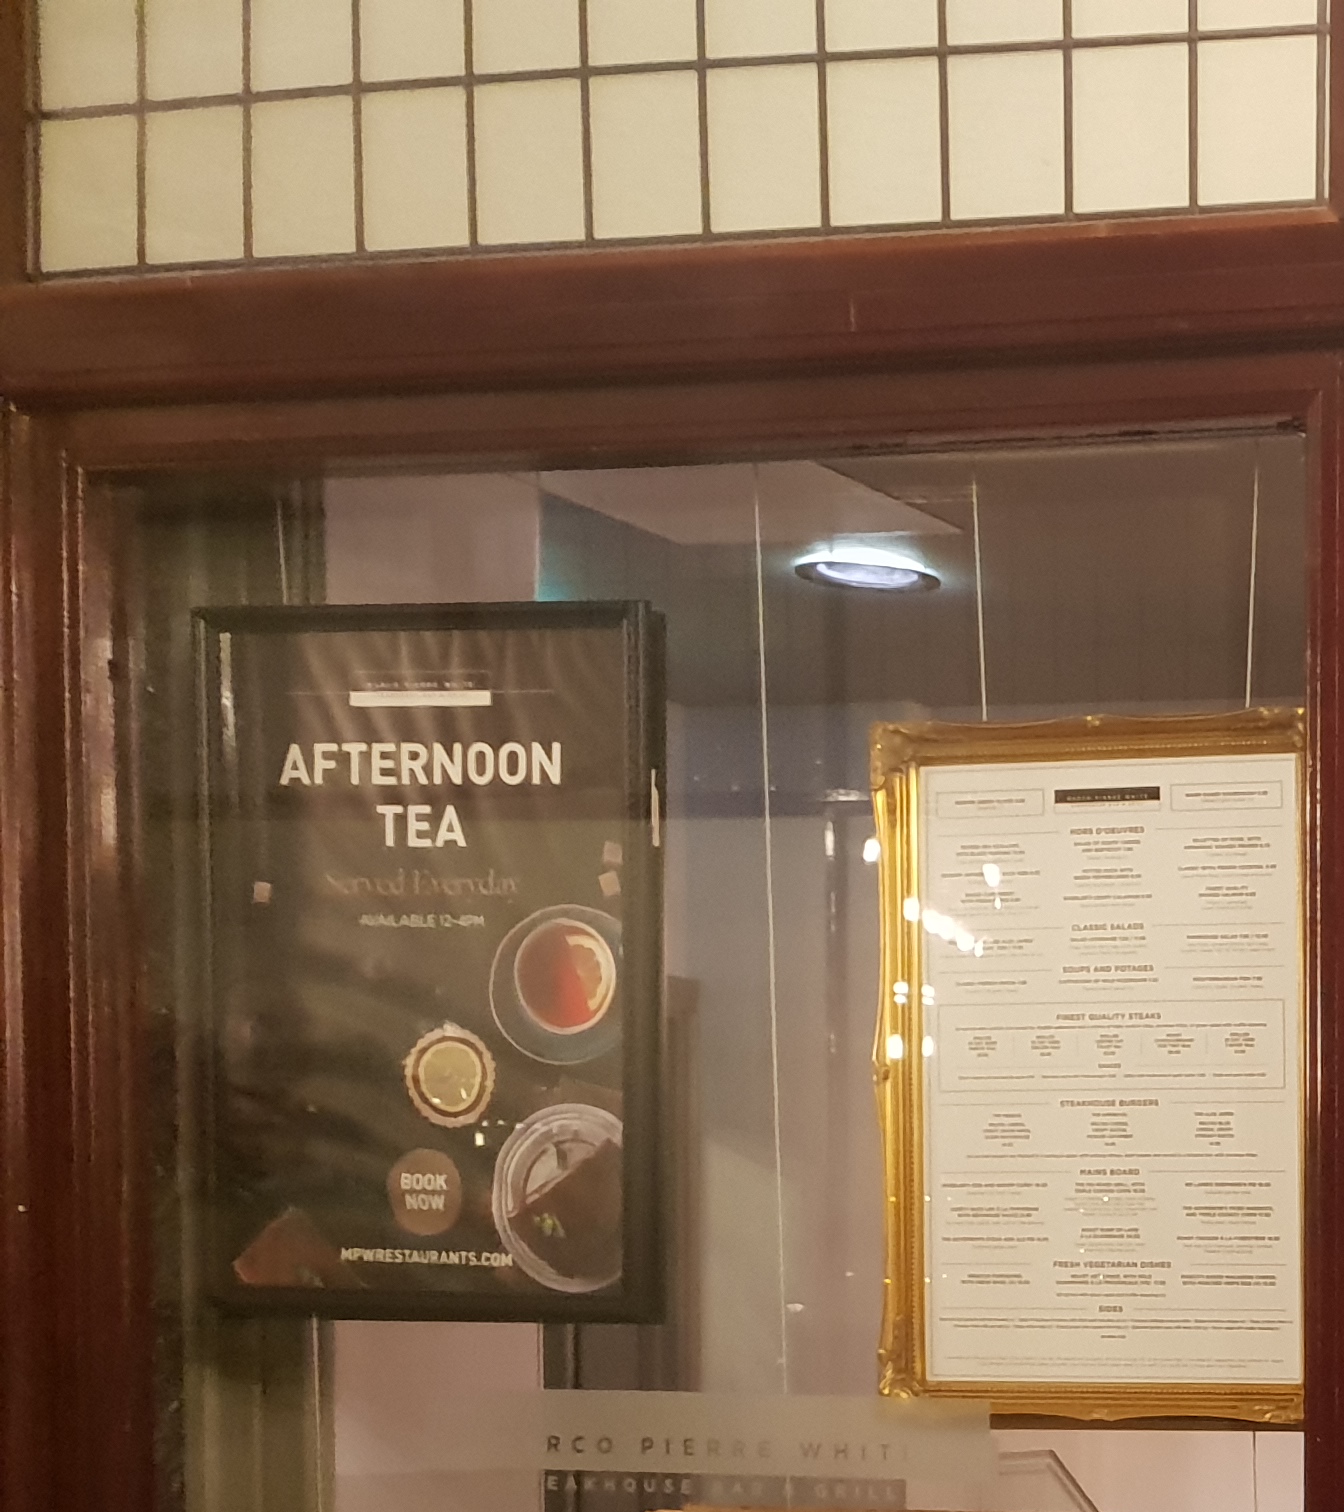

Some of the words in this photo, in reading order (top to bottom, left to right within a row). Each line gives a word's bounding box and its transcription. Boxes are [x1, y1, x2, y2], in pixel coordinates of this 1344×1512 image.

[279, 741, 563, 788] AFTERNOON
[376, 803, 467, 849] TEA
[359, 913, 437, 928] AVAILABLE
[1088, 1012, 1126, 1021] QUALITY
[1128, 1012, 1162, 1021] STEAKS
[399, 1171, 448, 1192] BOOK
[1079, 1168, 1108, 1176] MAINS
[1109, 1168, 1140, 1176] BOARD
[405, 1193, 446, 1212] NOW
[340, 1246, 514, 1269] MPWRESTAURANTS.COM
[546, 1434, 614, 1455] RCO
[640, 1437, 771, 1459] PIERRE
[800, 1441, 908, 1462] WHIT
[546, 1476, 693, 1496] EAKHOUSE
[813, 1483, 898, 1500] GRILL
